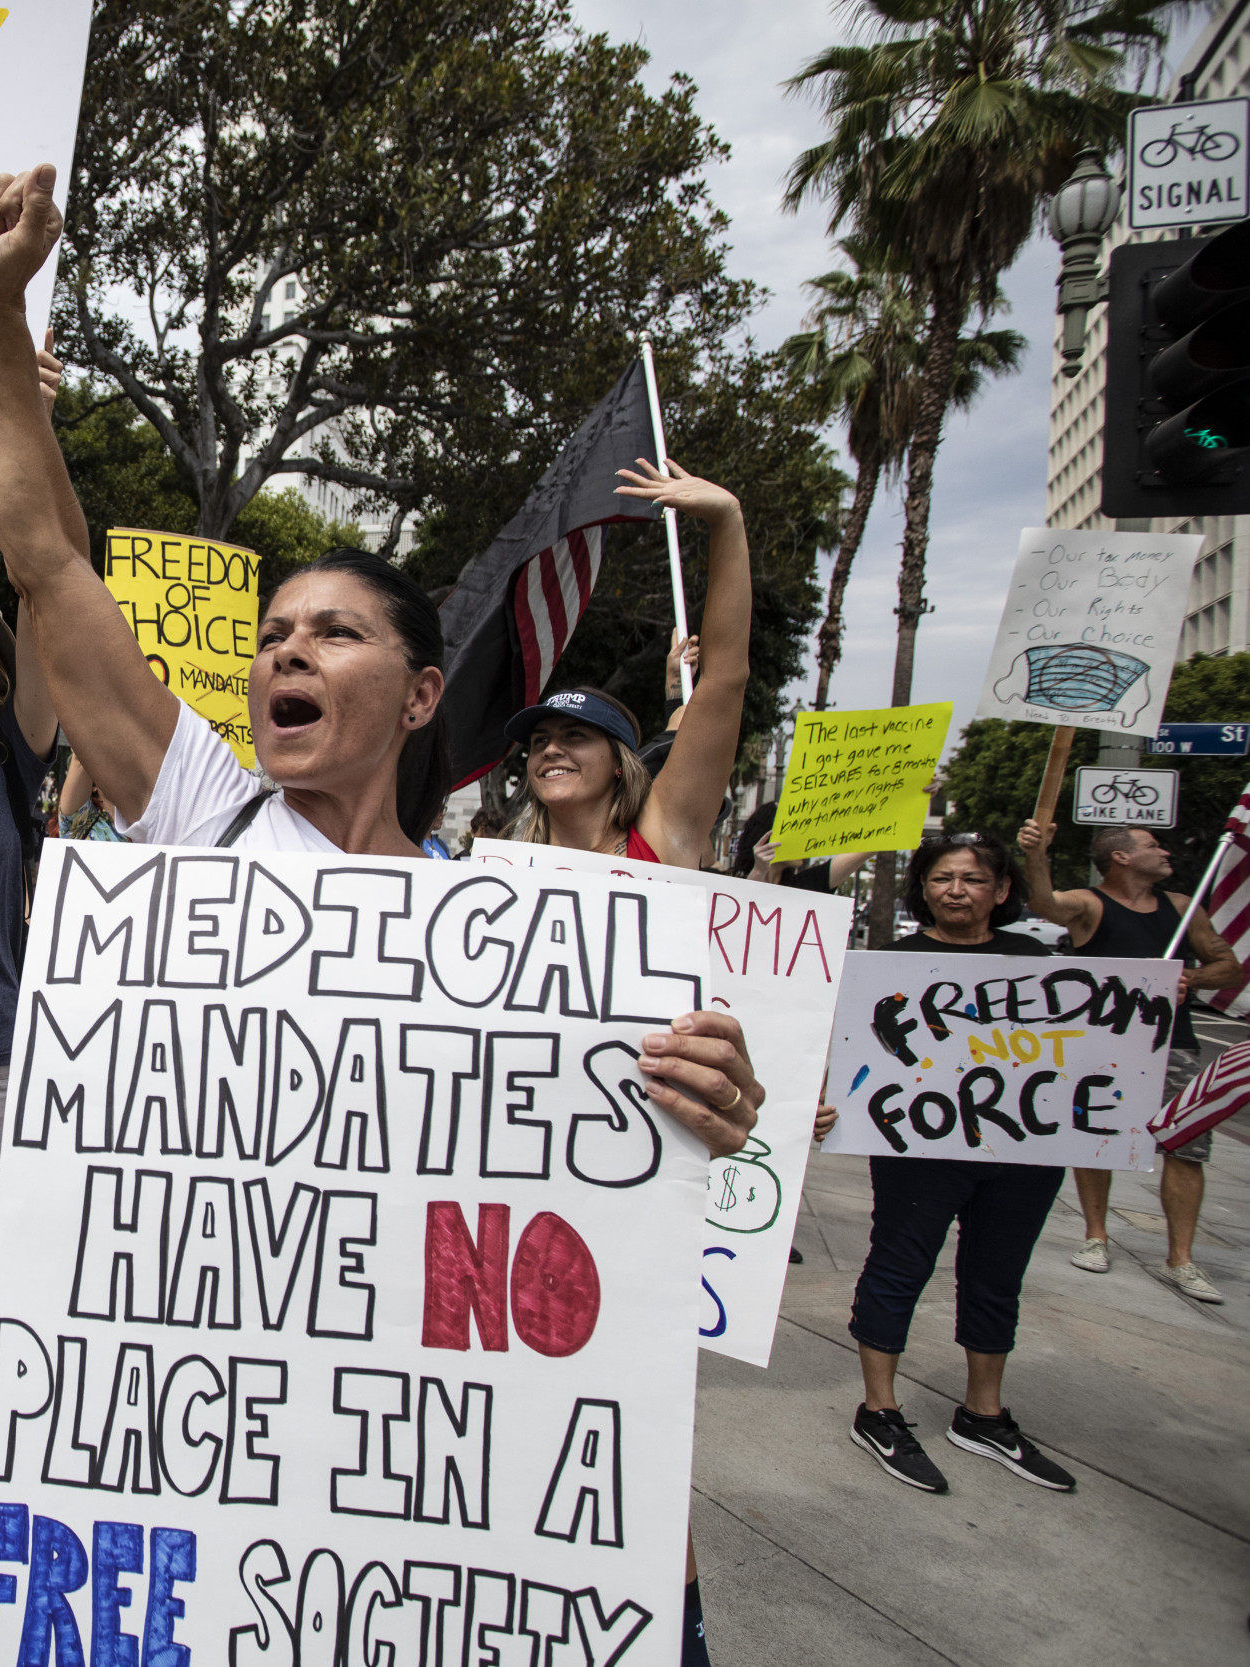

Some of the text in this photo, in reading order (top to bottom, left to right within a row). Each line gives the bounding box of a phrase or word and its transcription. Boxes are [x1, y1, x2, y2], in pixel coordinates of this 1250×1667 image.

[1139, 177, 1241, 211] SIGNAL
[106, 535, 261, 593] FREEDOM
[1039, 571, 1078, 591] Our
[165, 582, 211, 611] OF
[1032, 597, 1143, 621] Our Rights
[1026, 623, 1156, 649] Our Choice
[546, 693, 586, 706] TRUMP
[209, 719, 254, 744] PORTS
[804, 717, 933, 744] The last vaccine
[1221, 725, 1245, 742] St
[802, 743, 911, 773] I got gave me
[1151, 741, 1193, 753] 100 W
[789, 766, 862, 793] SEIZURES
[867, 764, 891, 777] for
[866, 778, 905, 798] rights
[1126, 808, 1166, 821] LANE
[804, 833, 838, 852] Don't
[46, 845, 703, 1025] MEDICAL
[708, 891, 832, 982] RMA
[870, 968, 1173, 1067] FREEDOM
[968, 1028, 1086, 1068] NOT
[13, 990, 662, 1188] MANDATES
[868, 1065, 1121, 1153] FORCE
[68, 1164, 378, 1342] HAVE
[422, 1200, 601, 1357] NO
[330, 1366, 493, 1530] IN
[534, 1397, 625, 1548] A
